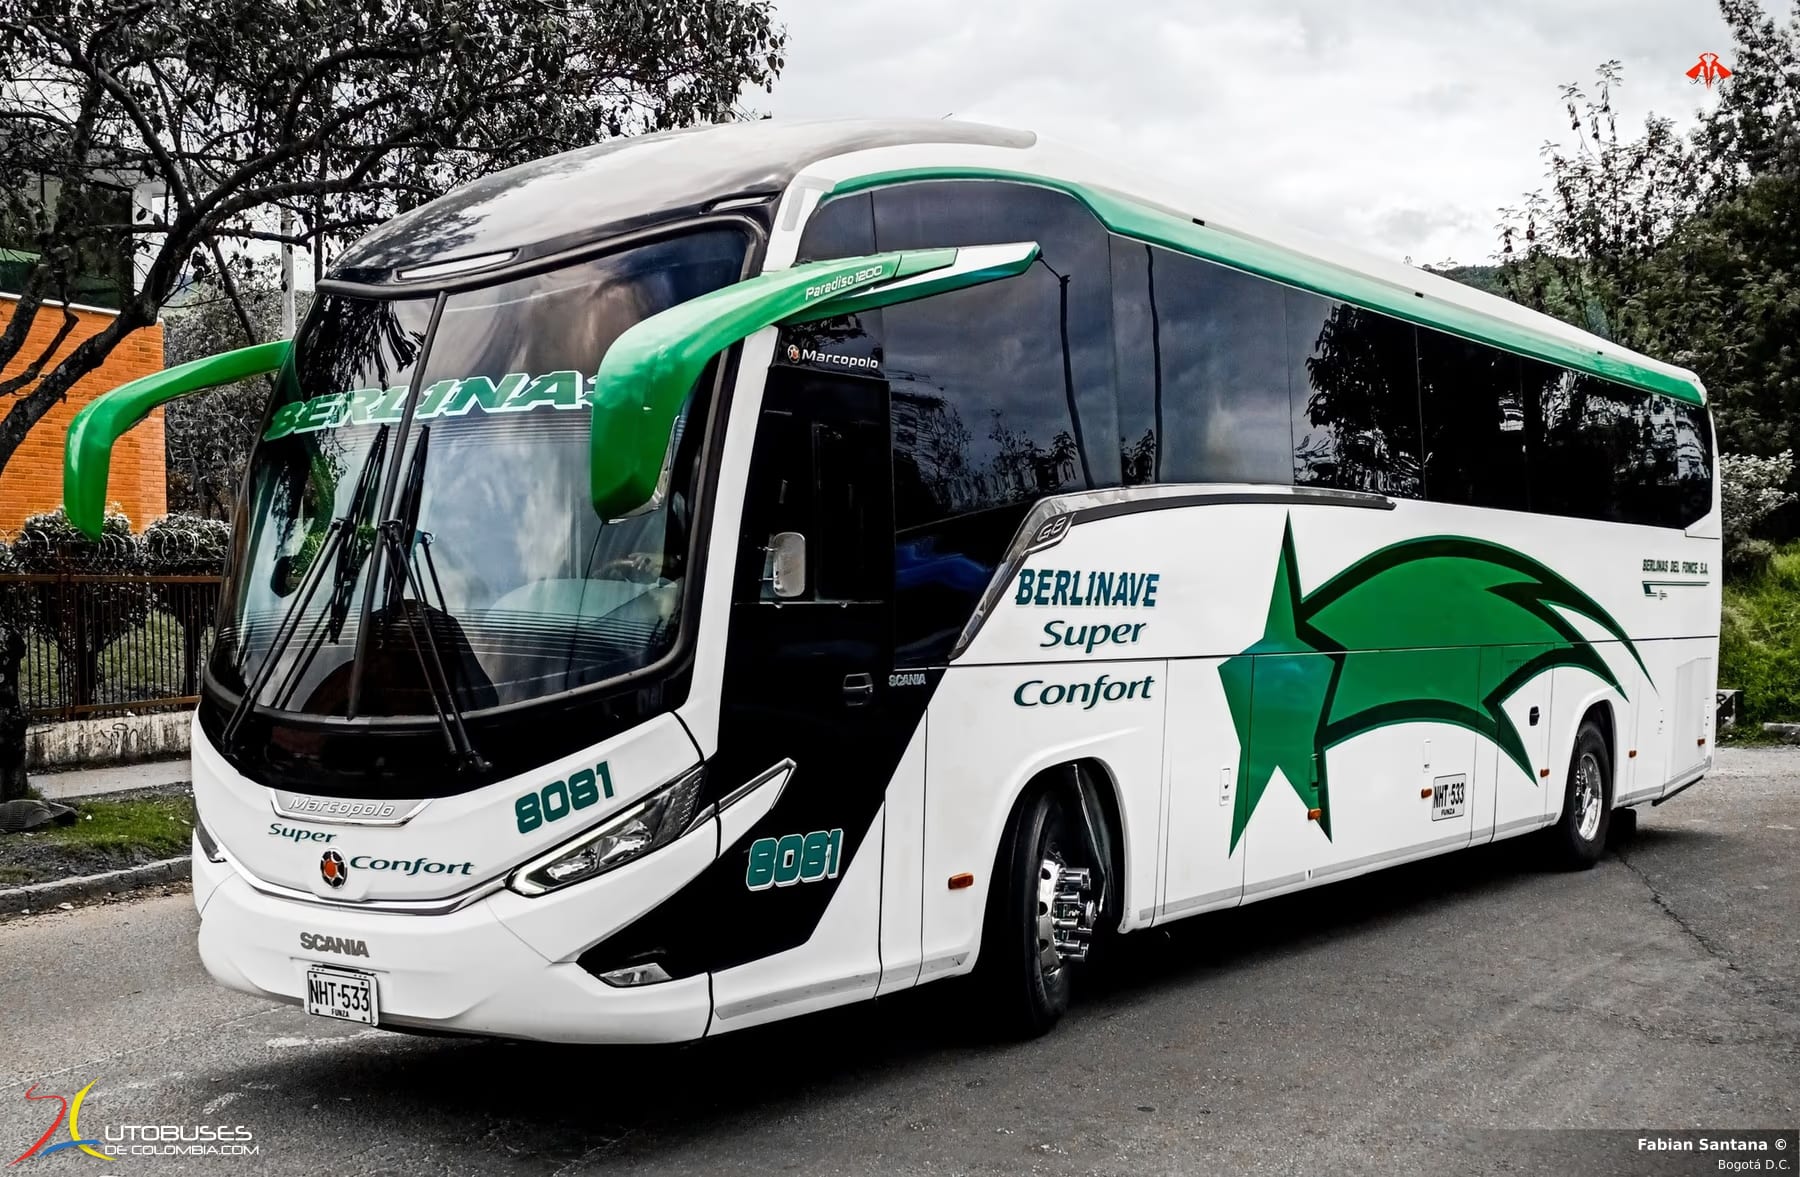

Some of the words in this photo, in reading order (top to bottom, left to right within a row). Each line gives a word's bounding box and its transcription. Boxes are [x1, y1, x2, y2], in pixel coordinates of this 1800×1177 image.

[805, 275, 854, 300] Paradiso
[855, 264, 883, 282] 1200
[801, 348, 879, 369] Marcopolo
[1036, 517, 1067, 542] G8
[1014, 568, 1161, 608] BERLINAVE
[1039, 620, 1147, 654] Super
[888, 673, 926, 687] SCANIA
[1013, 674, 1155, 710] Confort
[288, 796, 396, 817] Marcopolo
[514, 761, 615, 834] 8081
[268, 822, 337, 843] Super
[350, 854, 475, 876] Confort
[746, 828, 844, 891] 8081
[299, 931, 370, 958] SCANIA
[331, 1008, 350, 1018] FUNZA
